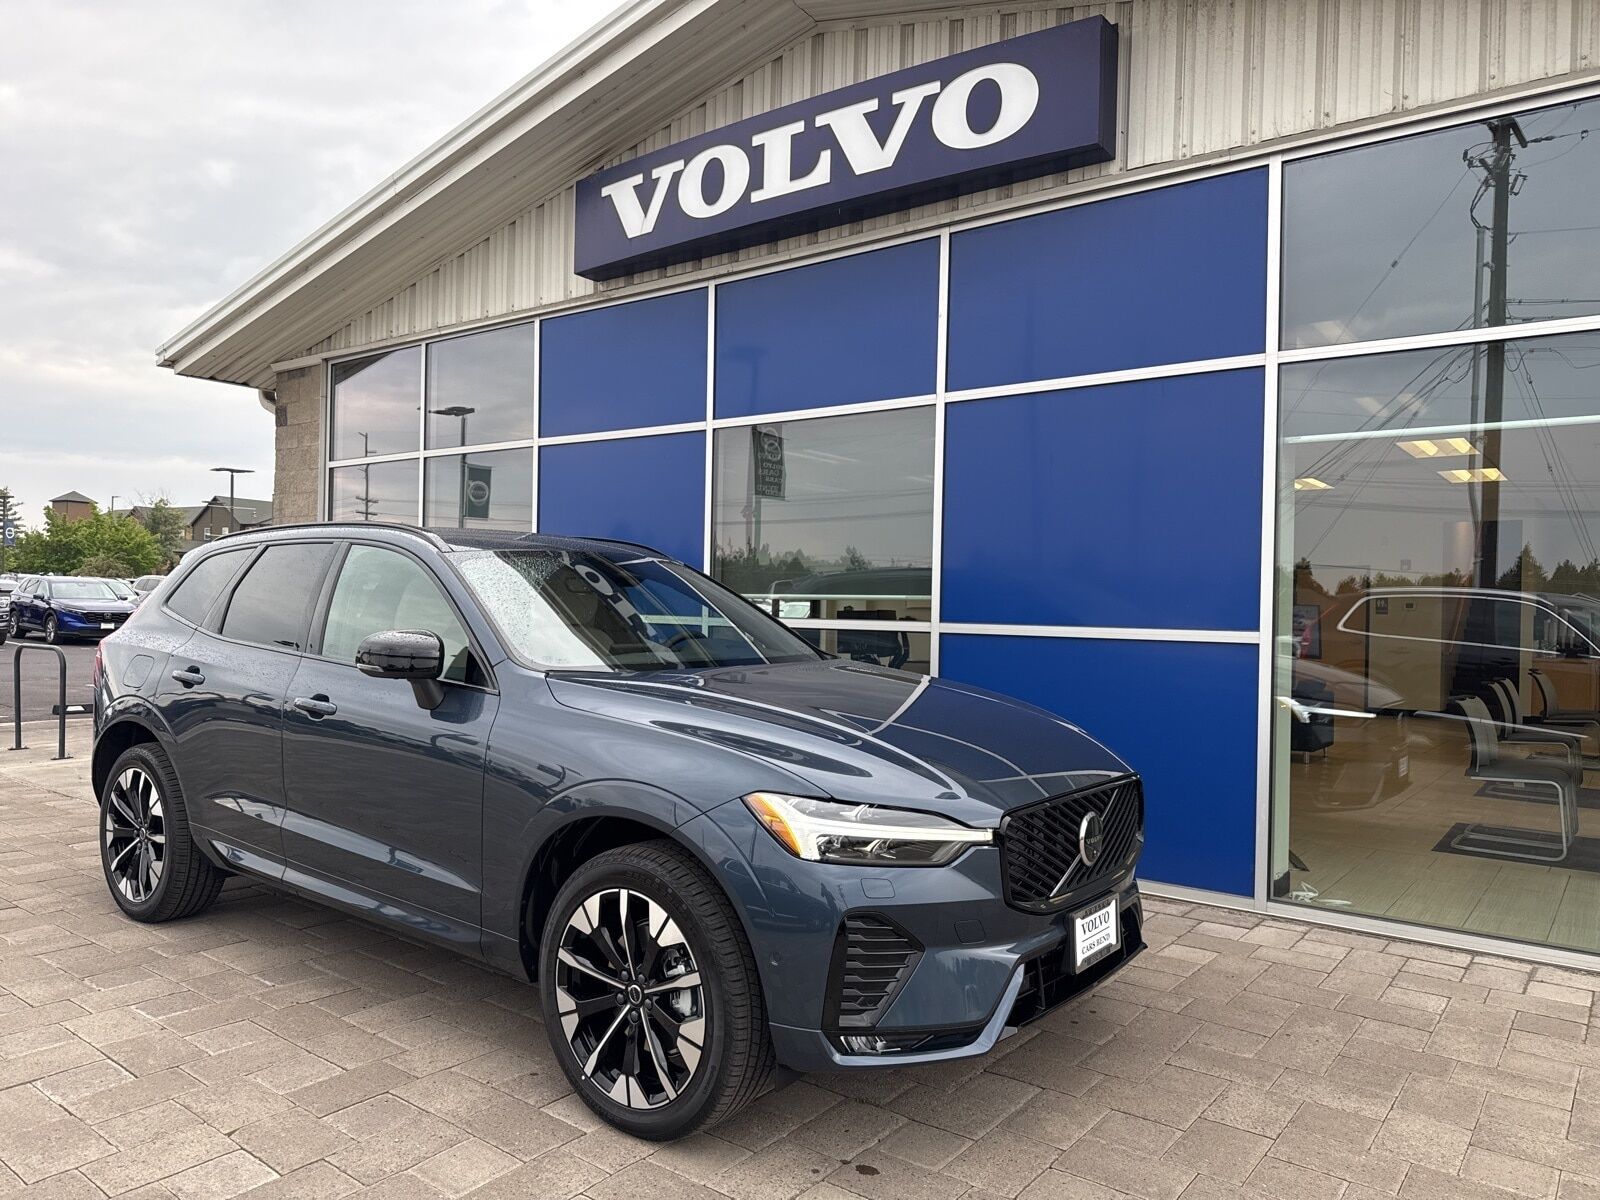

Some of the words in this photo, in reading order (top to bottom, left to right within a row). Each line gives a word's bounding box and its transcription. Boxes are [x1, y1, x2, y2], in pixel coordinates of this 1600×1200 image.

[601, 63, 1039, 239] VOLVO
[1081, 910, 1110, 936] VOLVO
[1081, 941, 1096, 955] CARS
[1096, 932, 1111, 946] BEND
